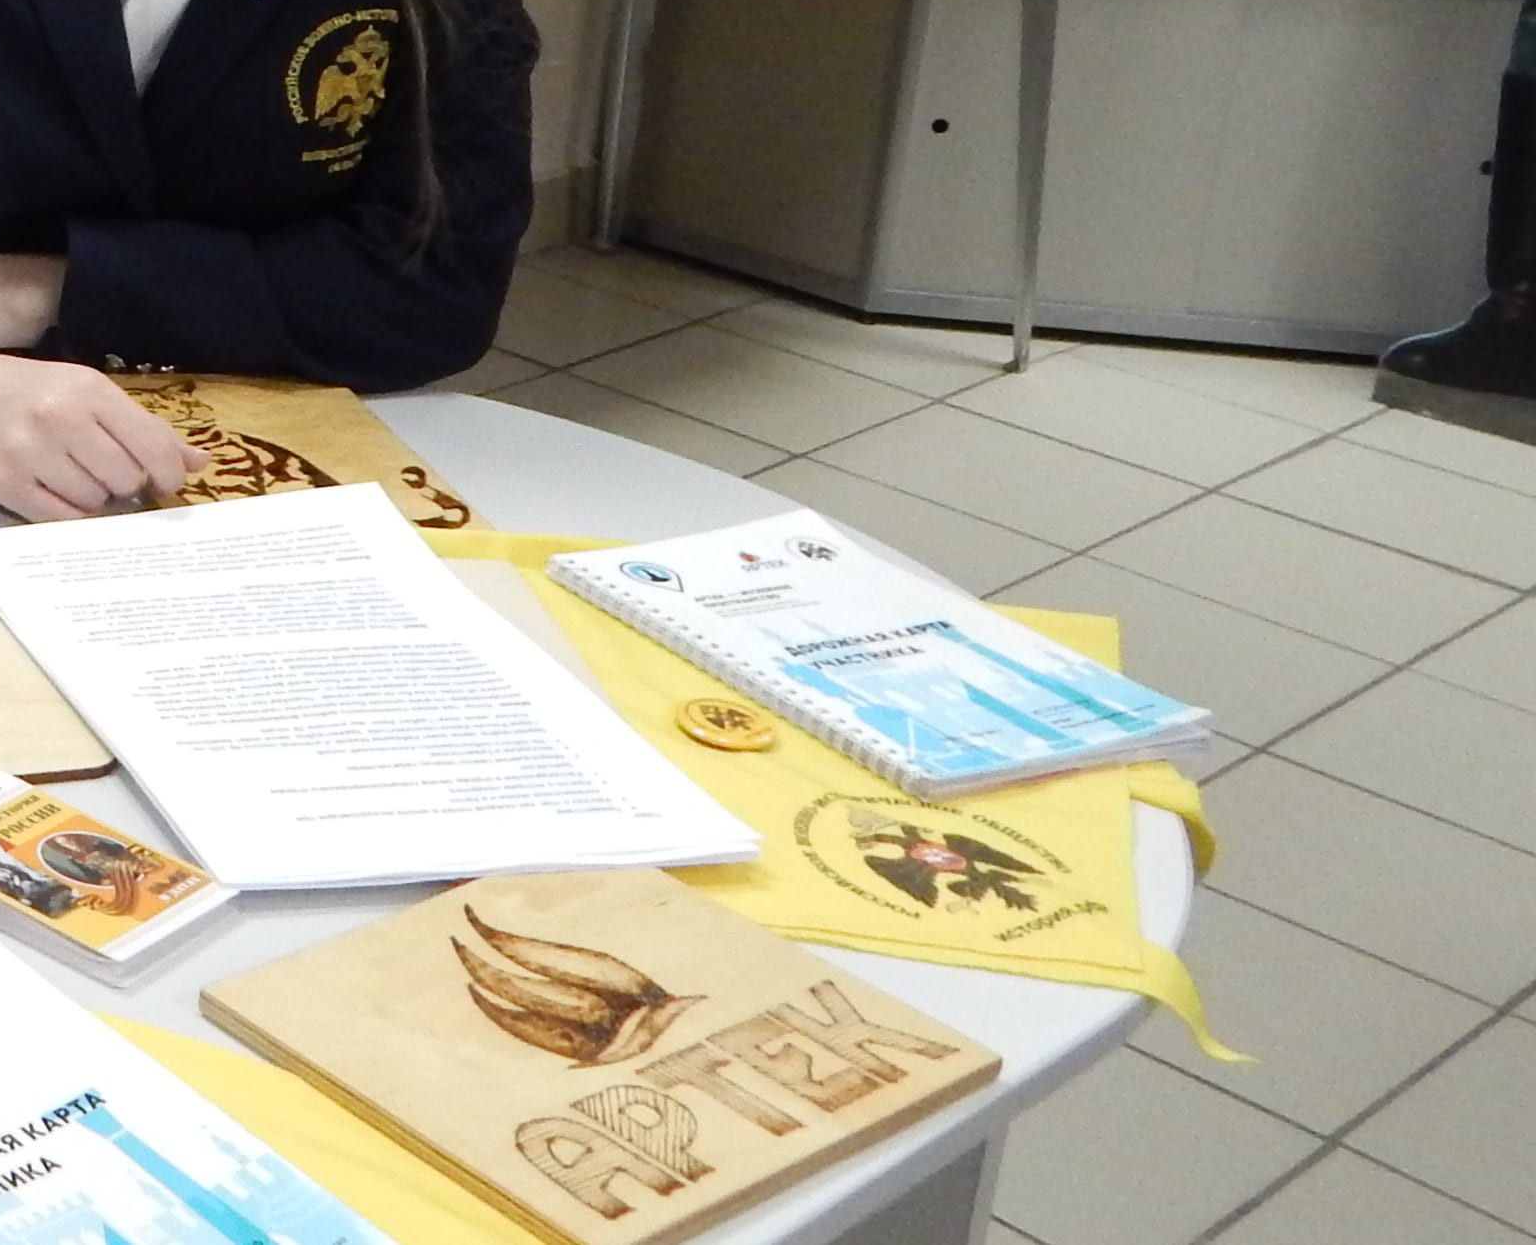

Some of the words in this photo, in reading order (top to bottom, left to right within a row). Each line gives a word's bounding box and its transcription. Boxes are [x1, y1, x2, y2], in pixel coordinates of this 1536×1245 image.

[784, 631, 889, 658] ДОРОЖНАЯ
[891, 620, 955, 640] КАРТА
[810, 645, 926, 671] УЧАСТНИКА
[20, 1090, 107, 1142] КАРТА
[515, 979, 962, 1221] АРТЕК
